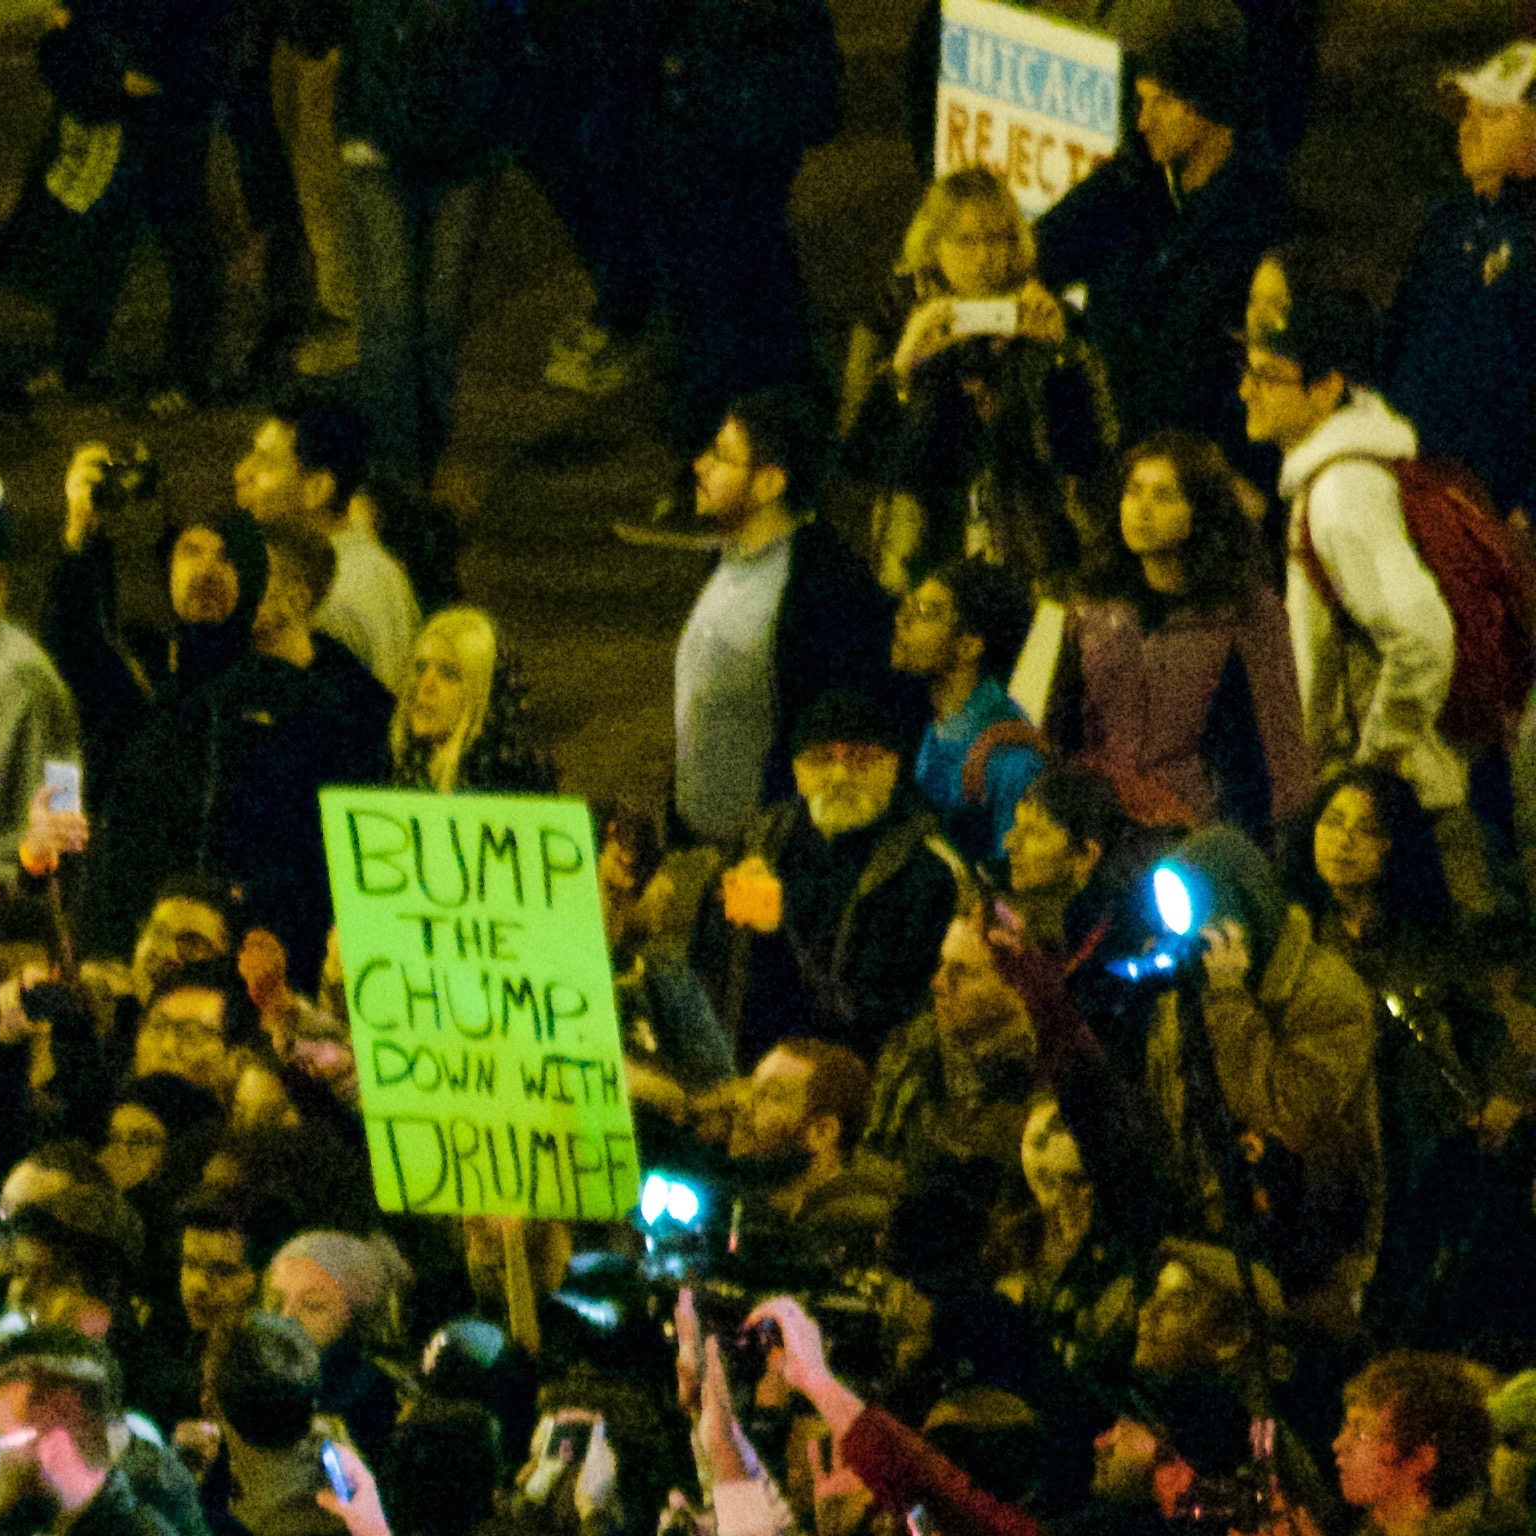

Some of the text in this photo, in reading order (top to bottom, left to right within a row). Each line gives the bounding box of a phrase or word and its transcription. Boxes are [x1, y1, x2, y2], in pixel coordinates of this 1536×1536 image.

[941, 21, 1116, 139] CHICAGO
[345, 808, 583, 910] BUMP
[395, 912, 525, 961] THE
[372, 1040, 619, 1104] DOWN WITH
